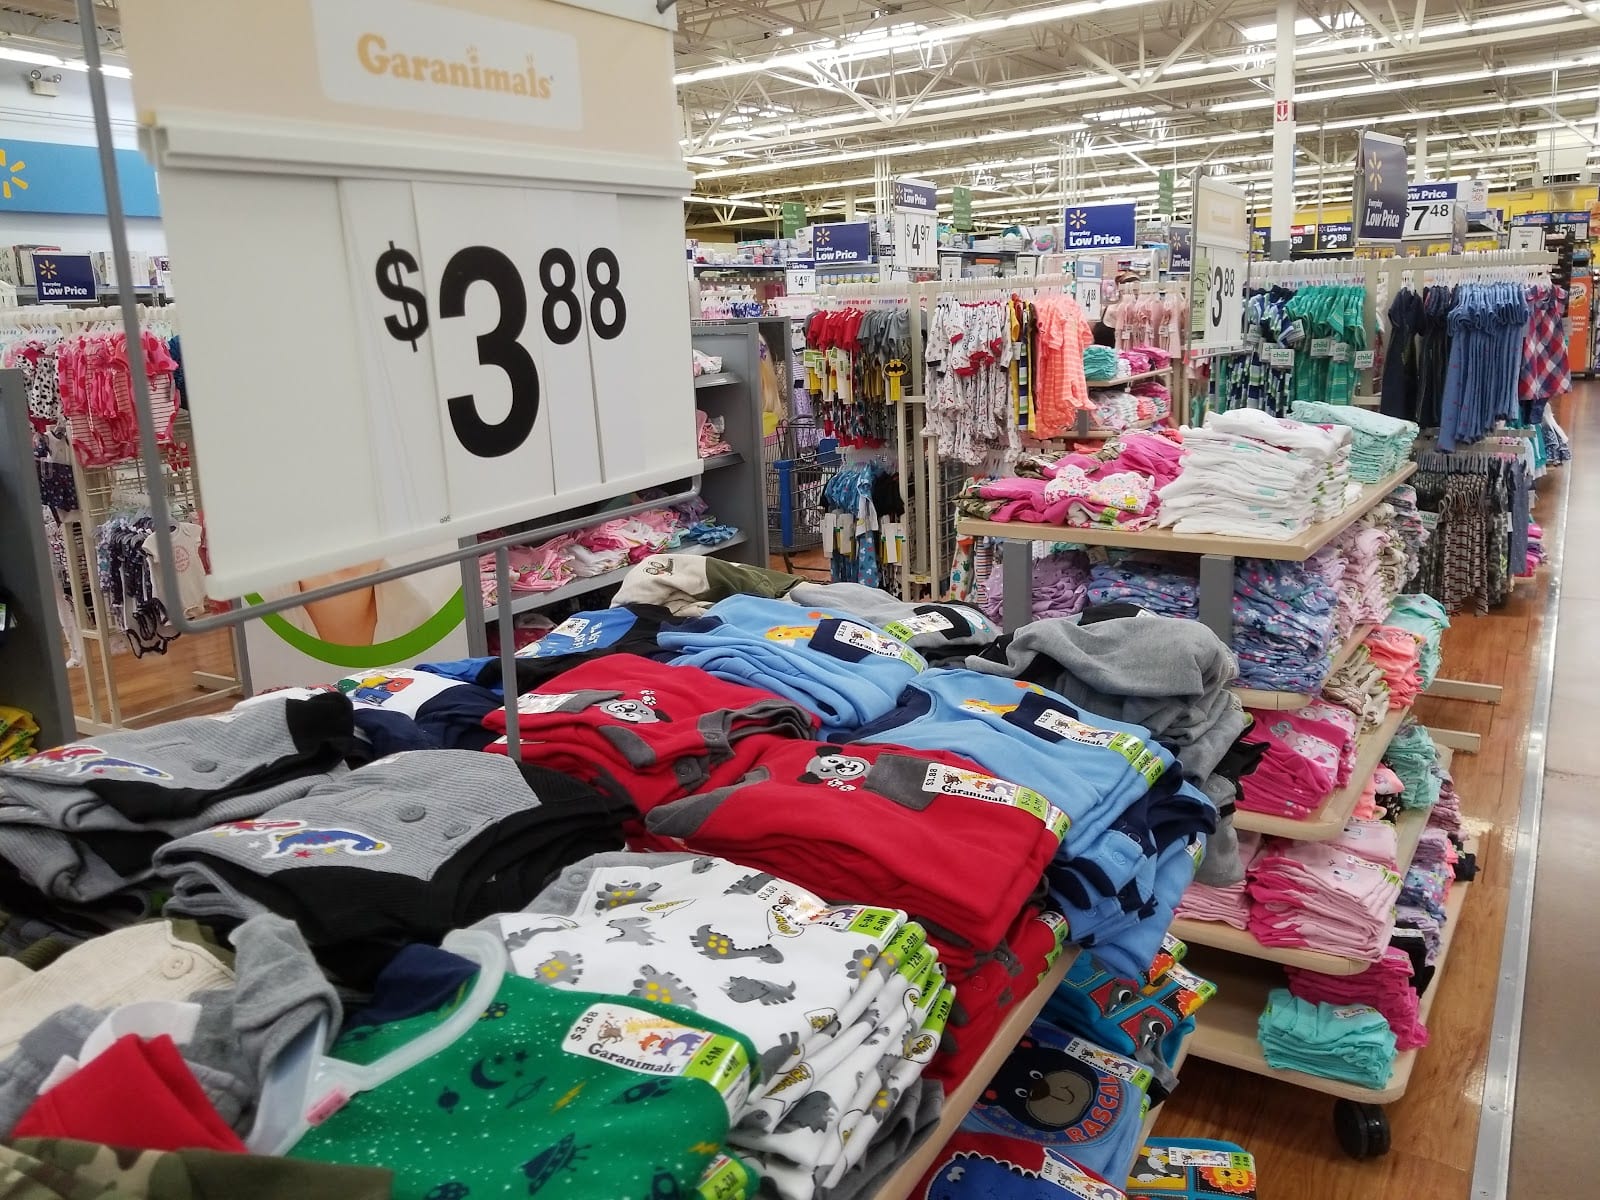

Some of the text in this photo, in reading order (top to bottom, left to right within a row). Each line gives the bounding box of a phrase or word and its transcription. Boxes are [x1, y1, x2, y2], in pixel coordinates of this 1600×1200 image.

[357, 32, 551, 99] Garanimals
[904, 192, 927, 205] Low Price
[1407, 190, 1448, 200] ow Price
[1365, 208, 1400, 228] Low Price
[1069, 234, 1122, 247] Low Price
[816, 250, 858, 260] Low Price
[43, 286, 87, 295] Low Price
[941, 784, 1009, 804] Garanimals
[758, 885, 778, 901] $3.88
[907, 952, 925, 970] 12M
[937, 1001, 951, 1022] 24M
[570, 1011, 599, 1042] $3.88
[588, 1042, 679, 1074] Garanimals
[700, 1046, 725, 1068] 24M
[1078, 1054, 1128, 1080] Garanimals
[1065, 1075, 1120, 1142] RASCAL
